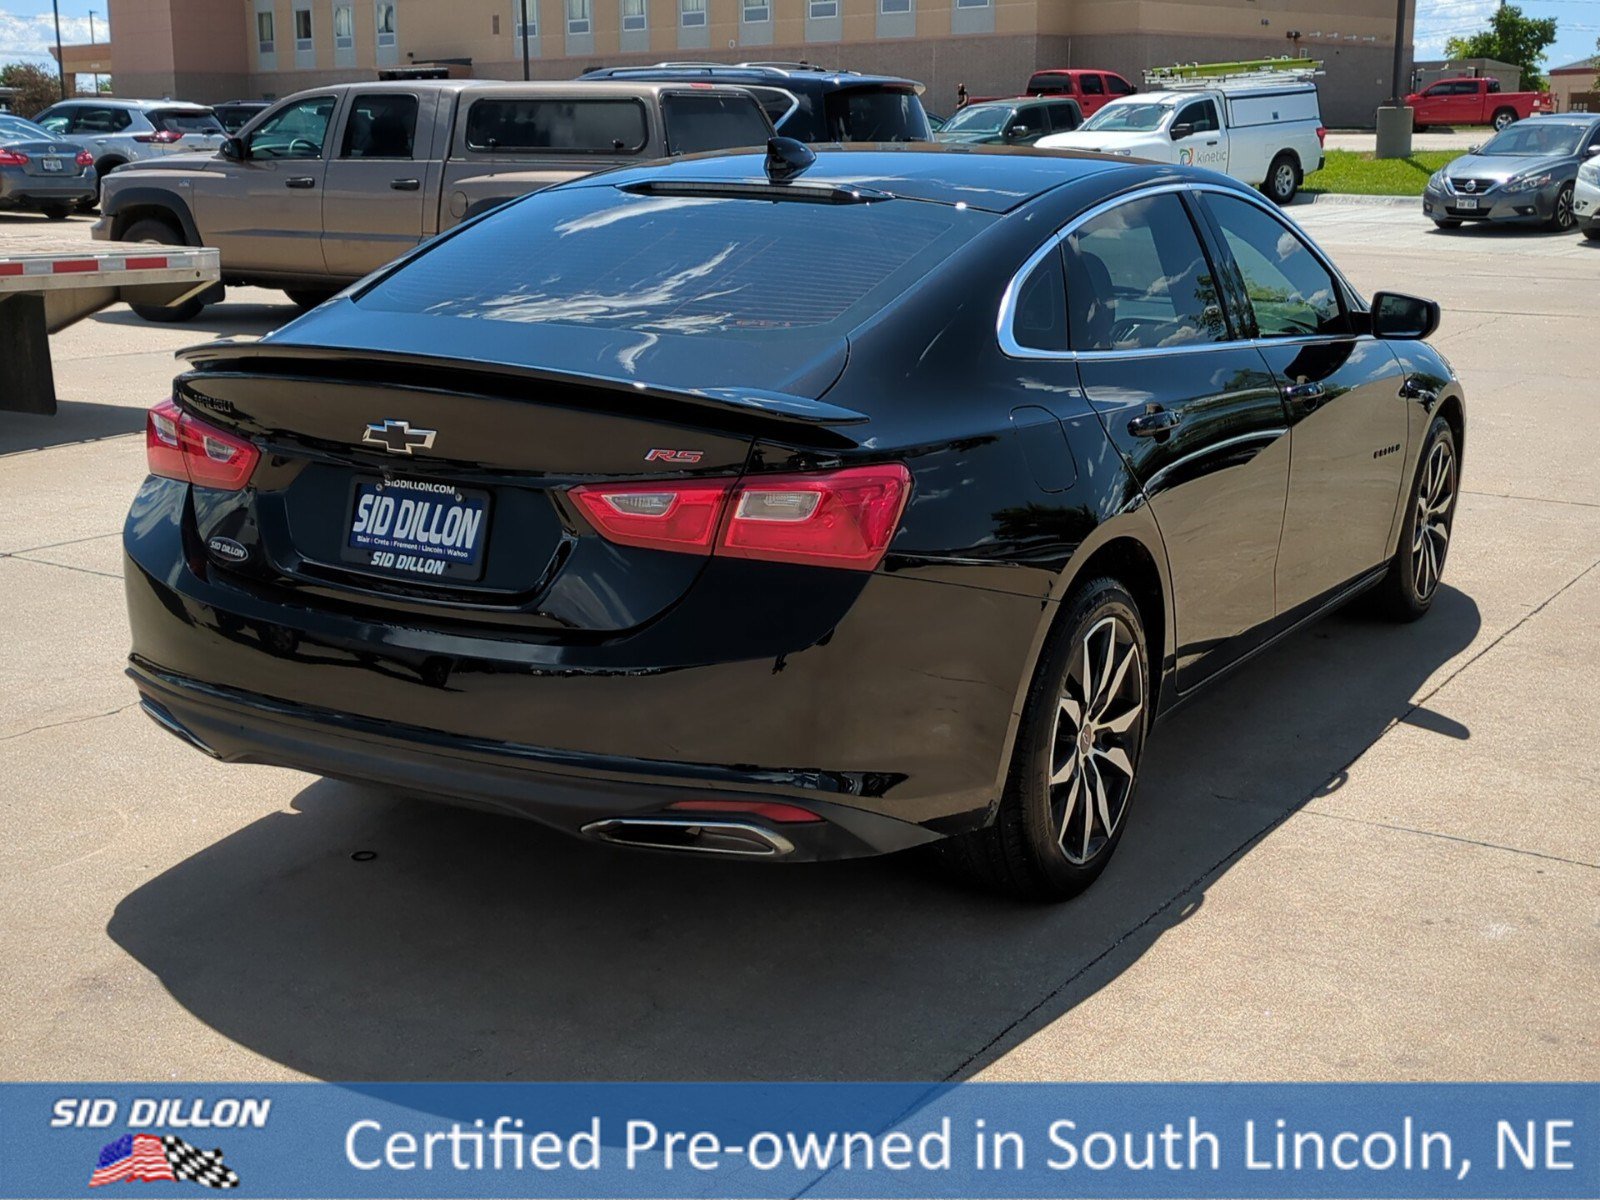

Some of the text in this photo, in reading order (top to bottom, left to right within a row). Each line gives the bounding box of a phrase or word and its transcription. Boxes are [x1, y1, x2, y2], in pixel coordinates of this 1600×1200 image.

[1196, 151, 1227, 163] kinetic
[644, 448, 704, 463] RS
[384, 479, 455, 495] SIDDILLON.COM
[352, 494, 482, 549] SID DILLON
[210, 541, 245, 558] SID DILLON
[357, 535, 468, 558] Blair Crete Fremont Lincoln Wahoo
[370, 551, 446, 575] SID DILLON
